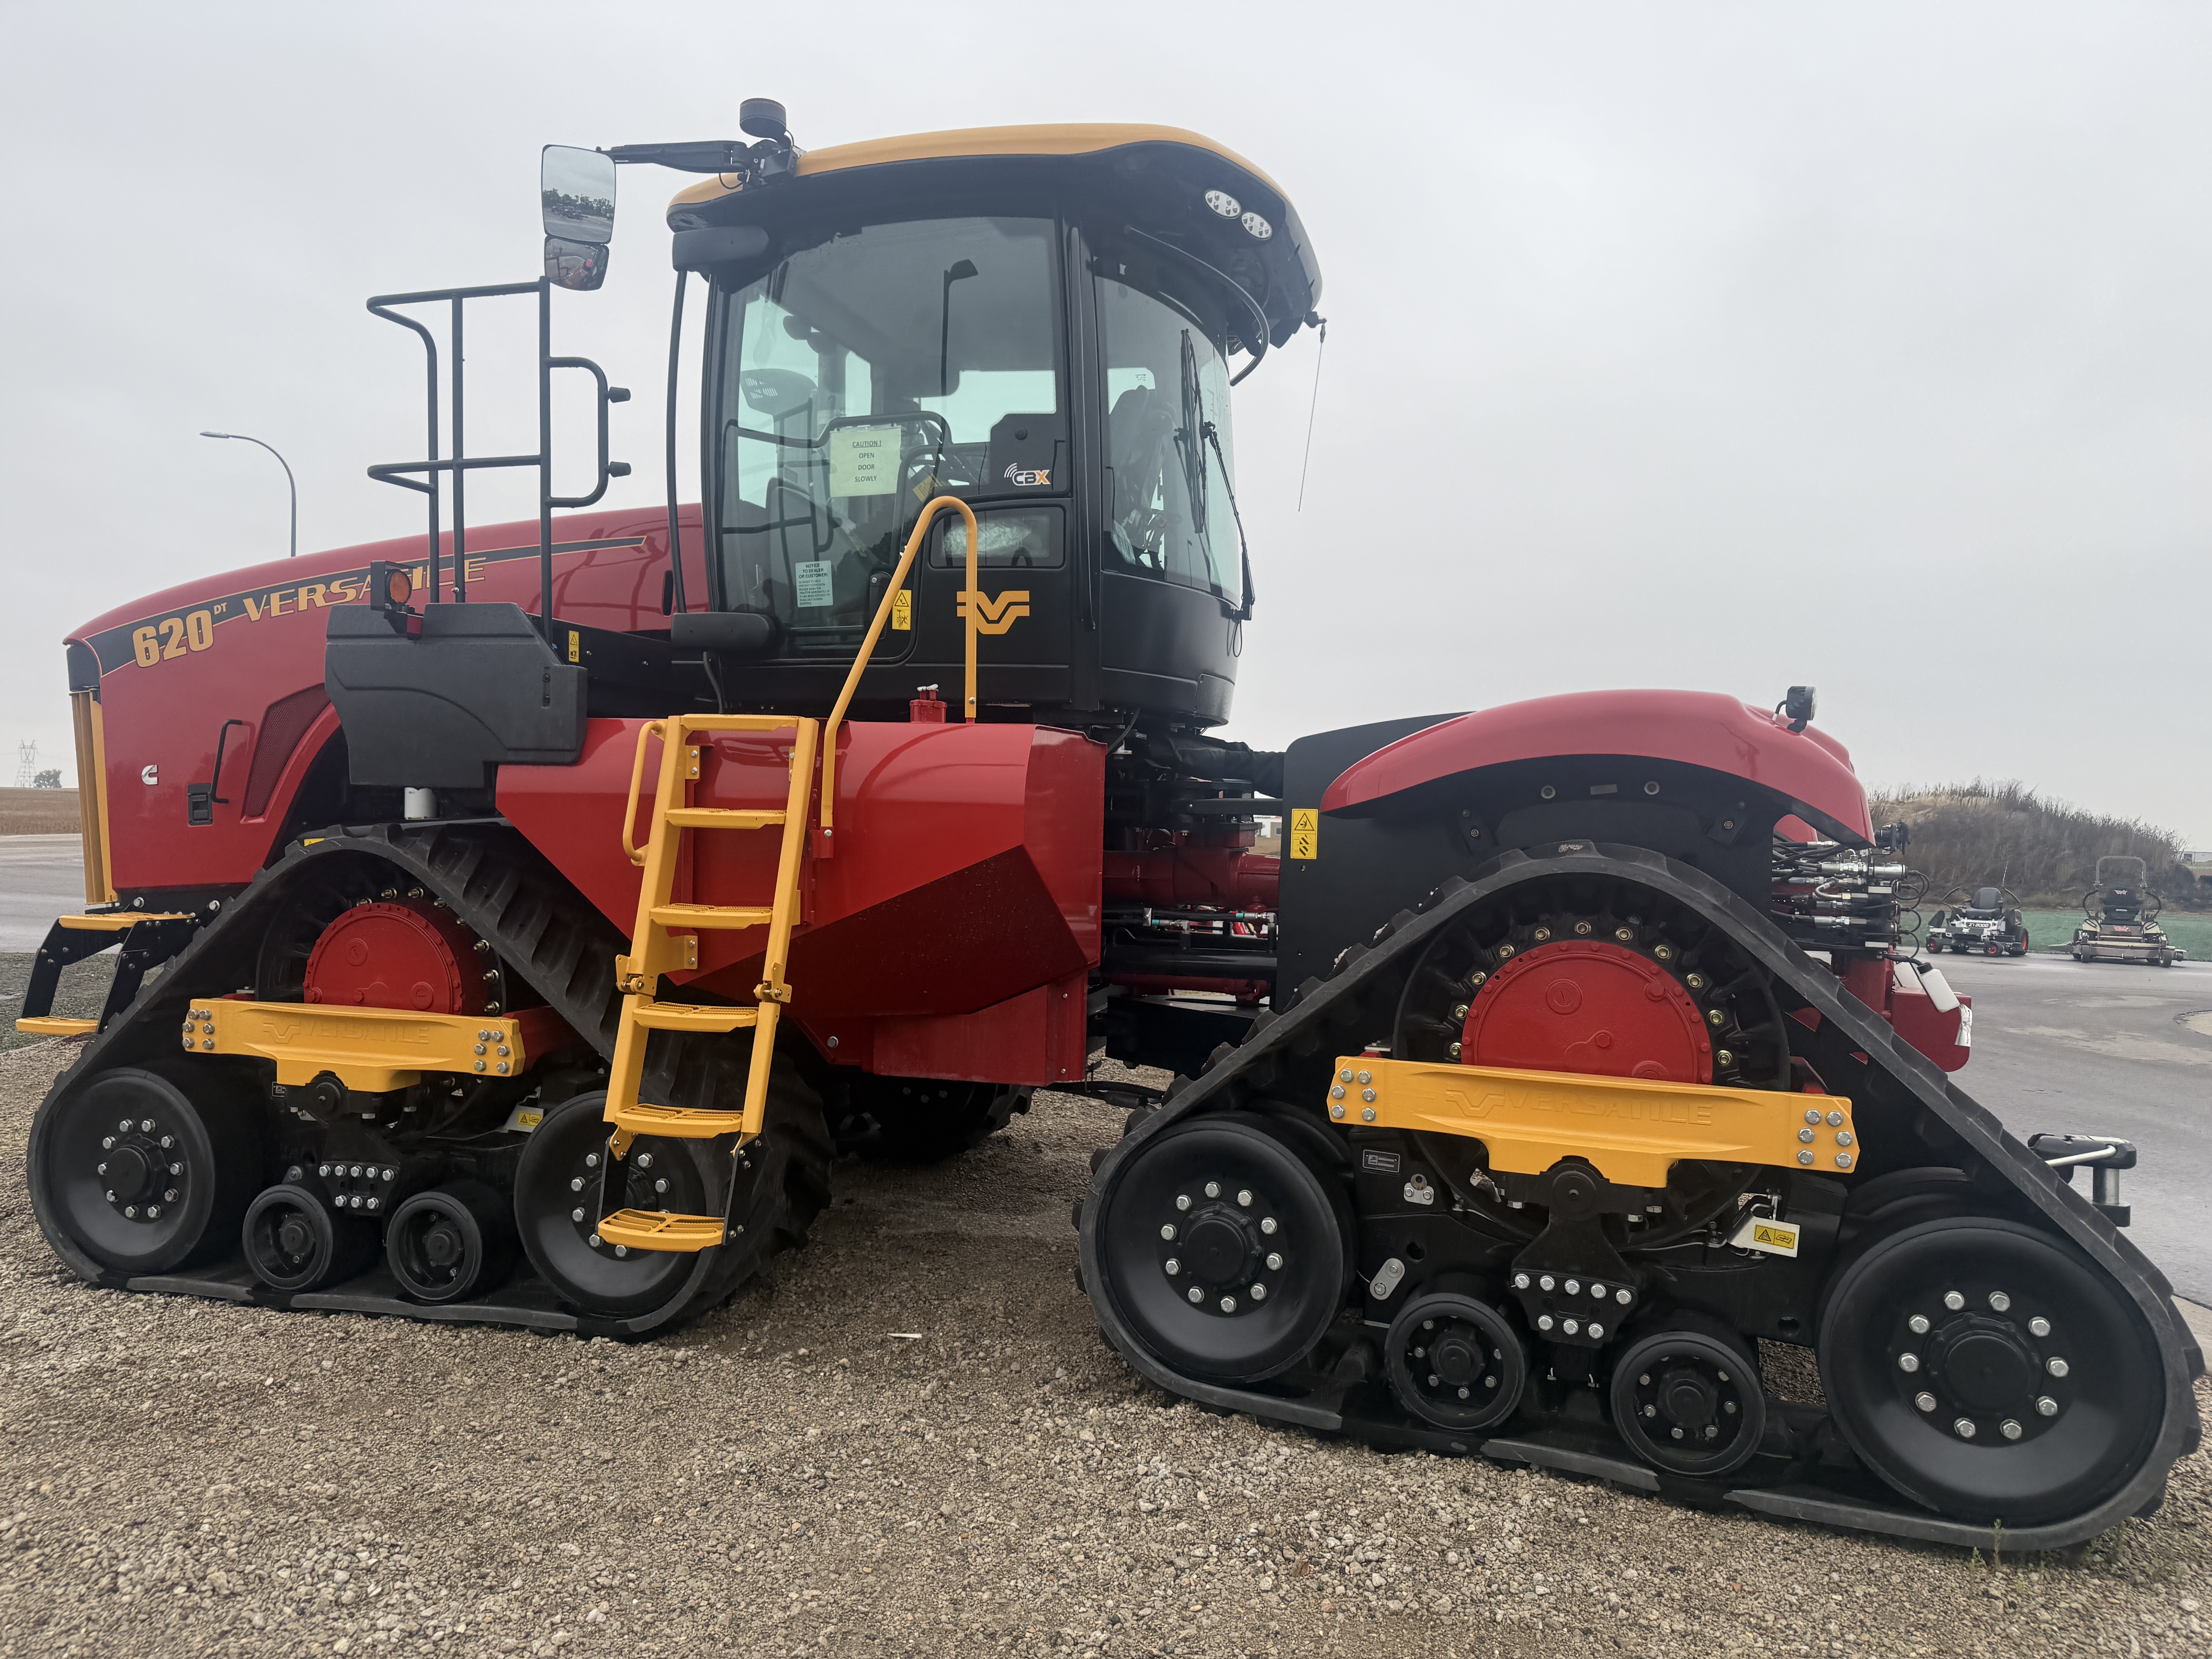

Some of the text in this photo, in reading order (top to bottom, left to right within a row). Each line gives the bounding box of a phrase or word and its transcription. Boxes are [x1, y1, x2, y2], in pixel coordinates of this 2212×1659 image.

[1012, 469, 1051, 486] CBX
[133, 557, 487, 668] 620 DT VERSILE
[1506, 1087, 1713, 1126] VERSATILE
